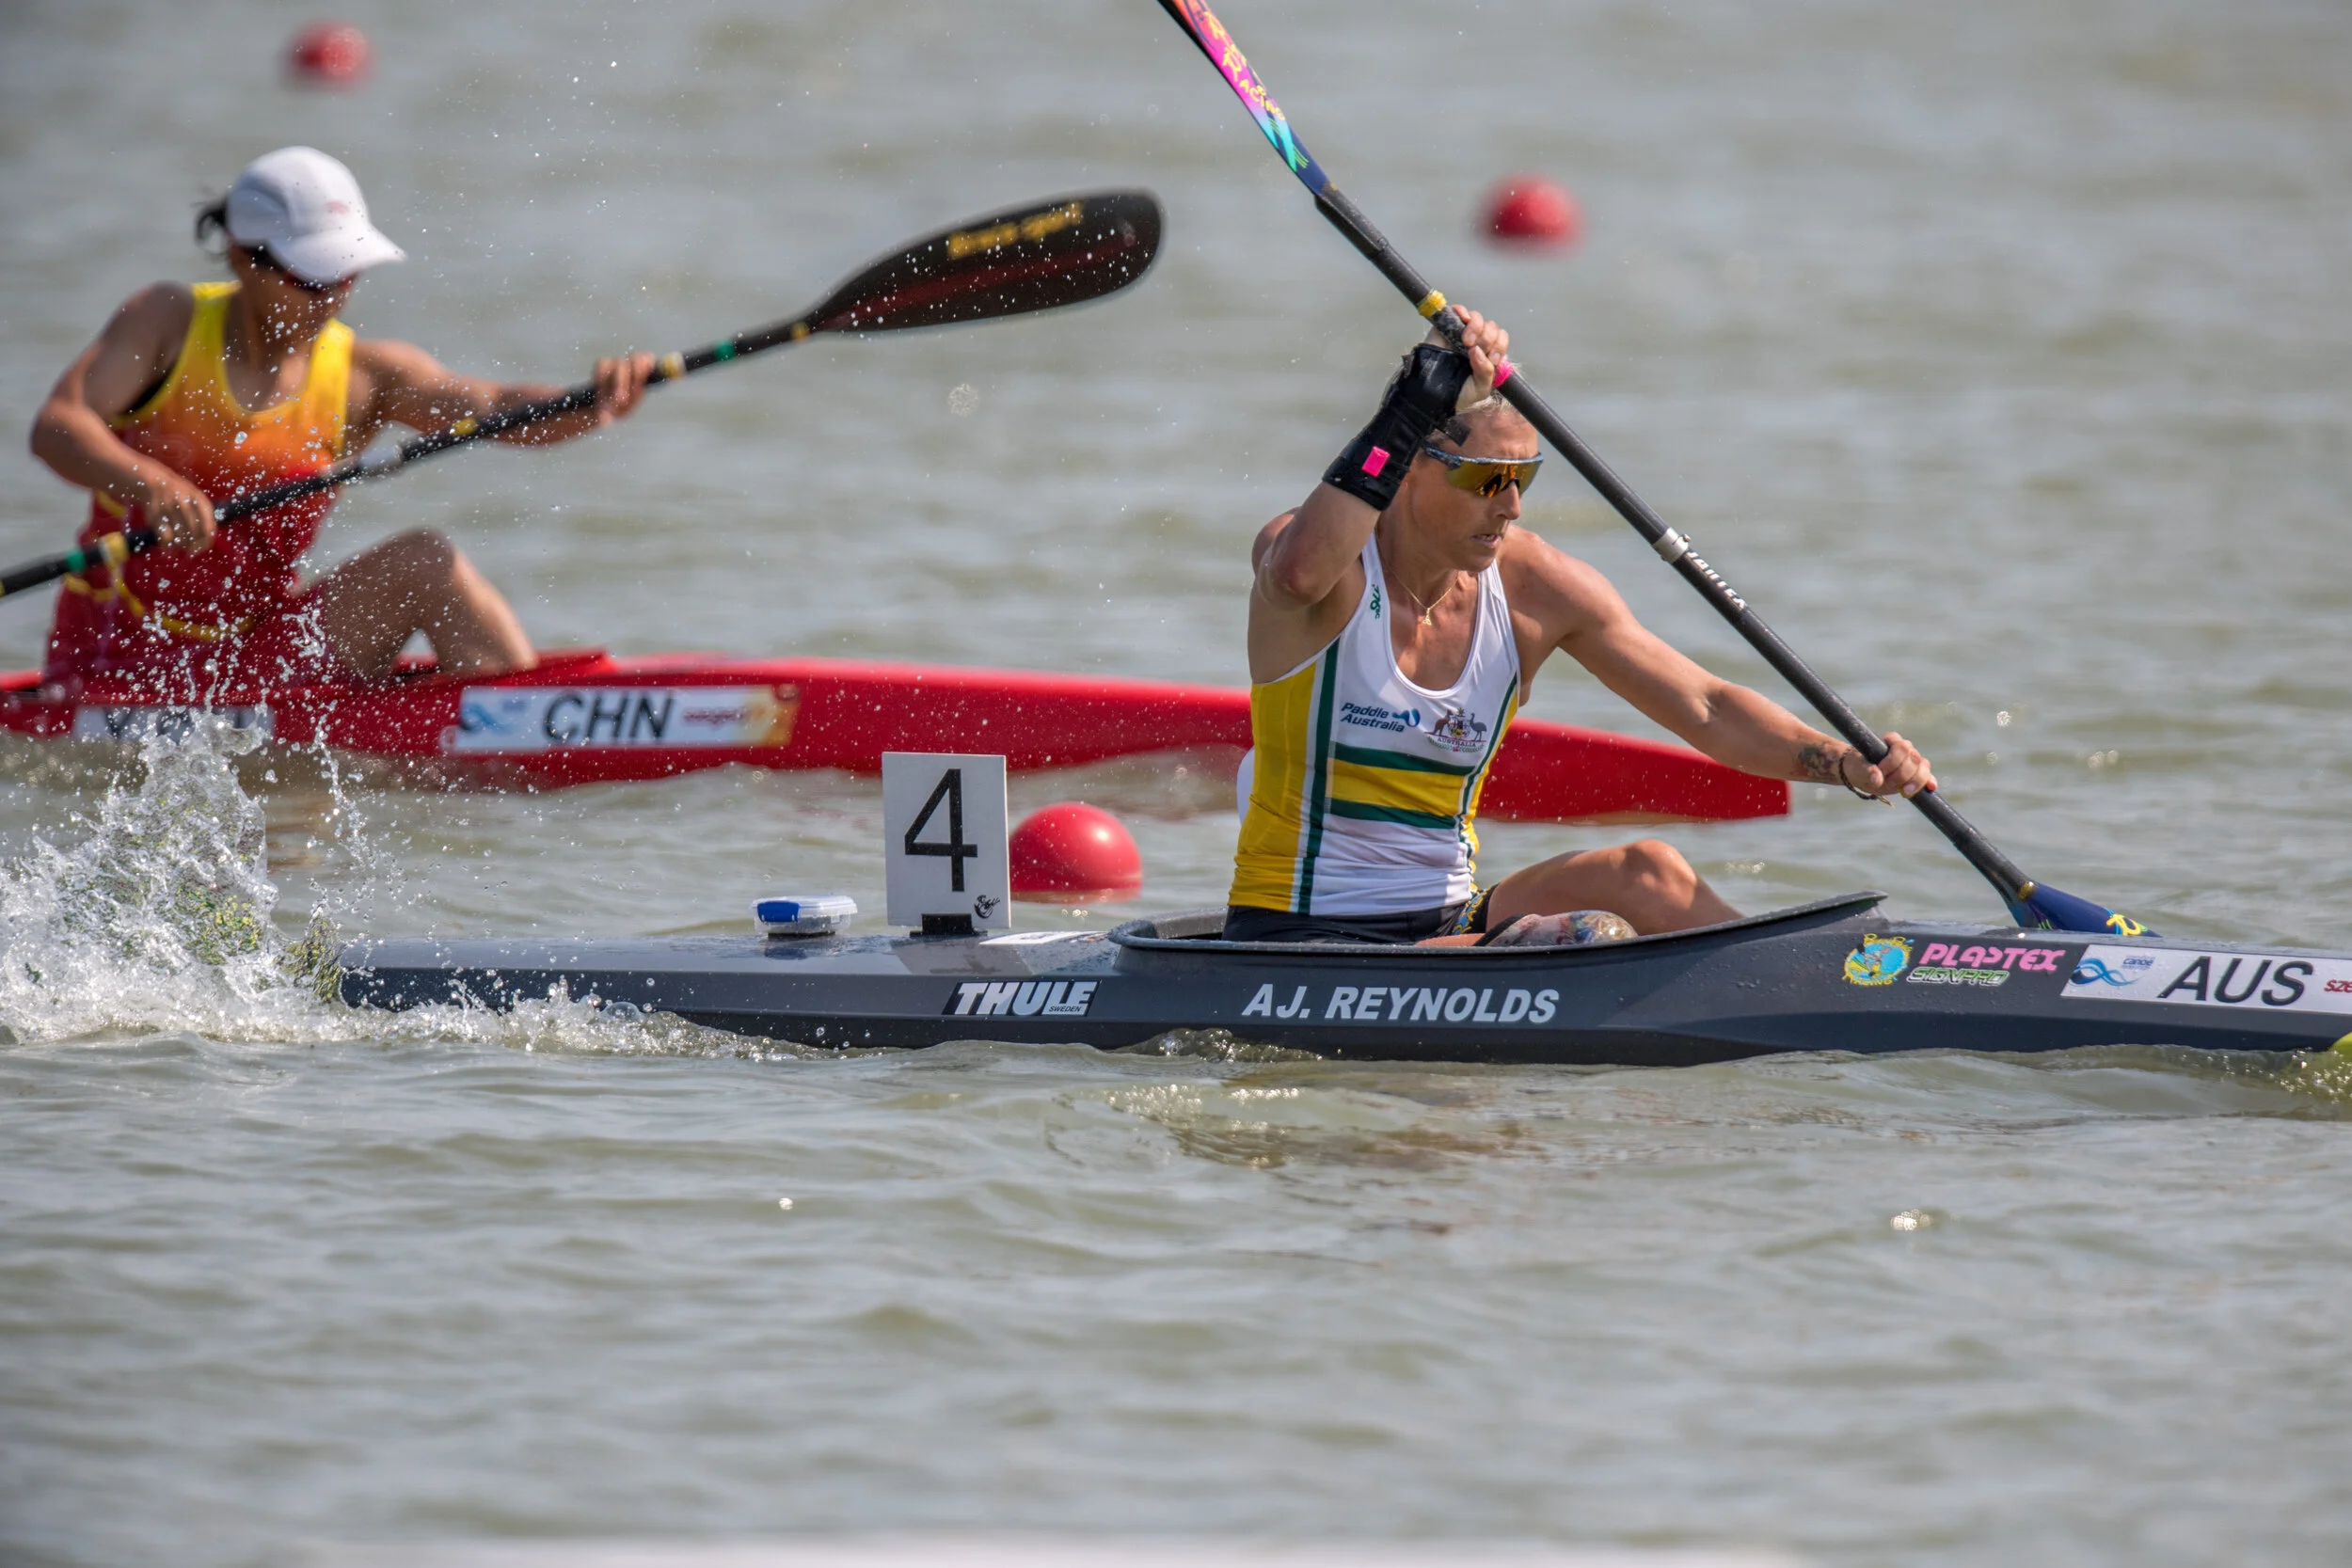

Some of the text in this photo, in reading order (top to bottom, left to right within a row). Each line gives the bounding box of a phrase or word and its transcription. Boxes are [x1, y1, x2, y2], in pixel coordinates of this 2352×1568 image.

[542, 691, 675, 743] CHN
[1341, 703, 1390, 719] Paddle
[1341, 714, 1405, 733] Australia
[1438, 736, 1477, 748] AUSTRALIA
[904, 768, 978, 892] 4
[954, 981, 1098, 1016] THULE
[2157, 956, 2313, 1006] AUS
[1325, 986, 1560, 1023] REYNOLDS
